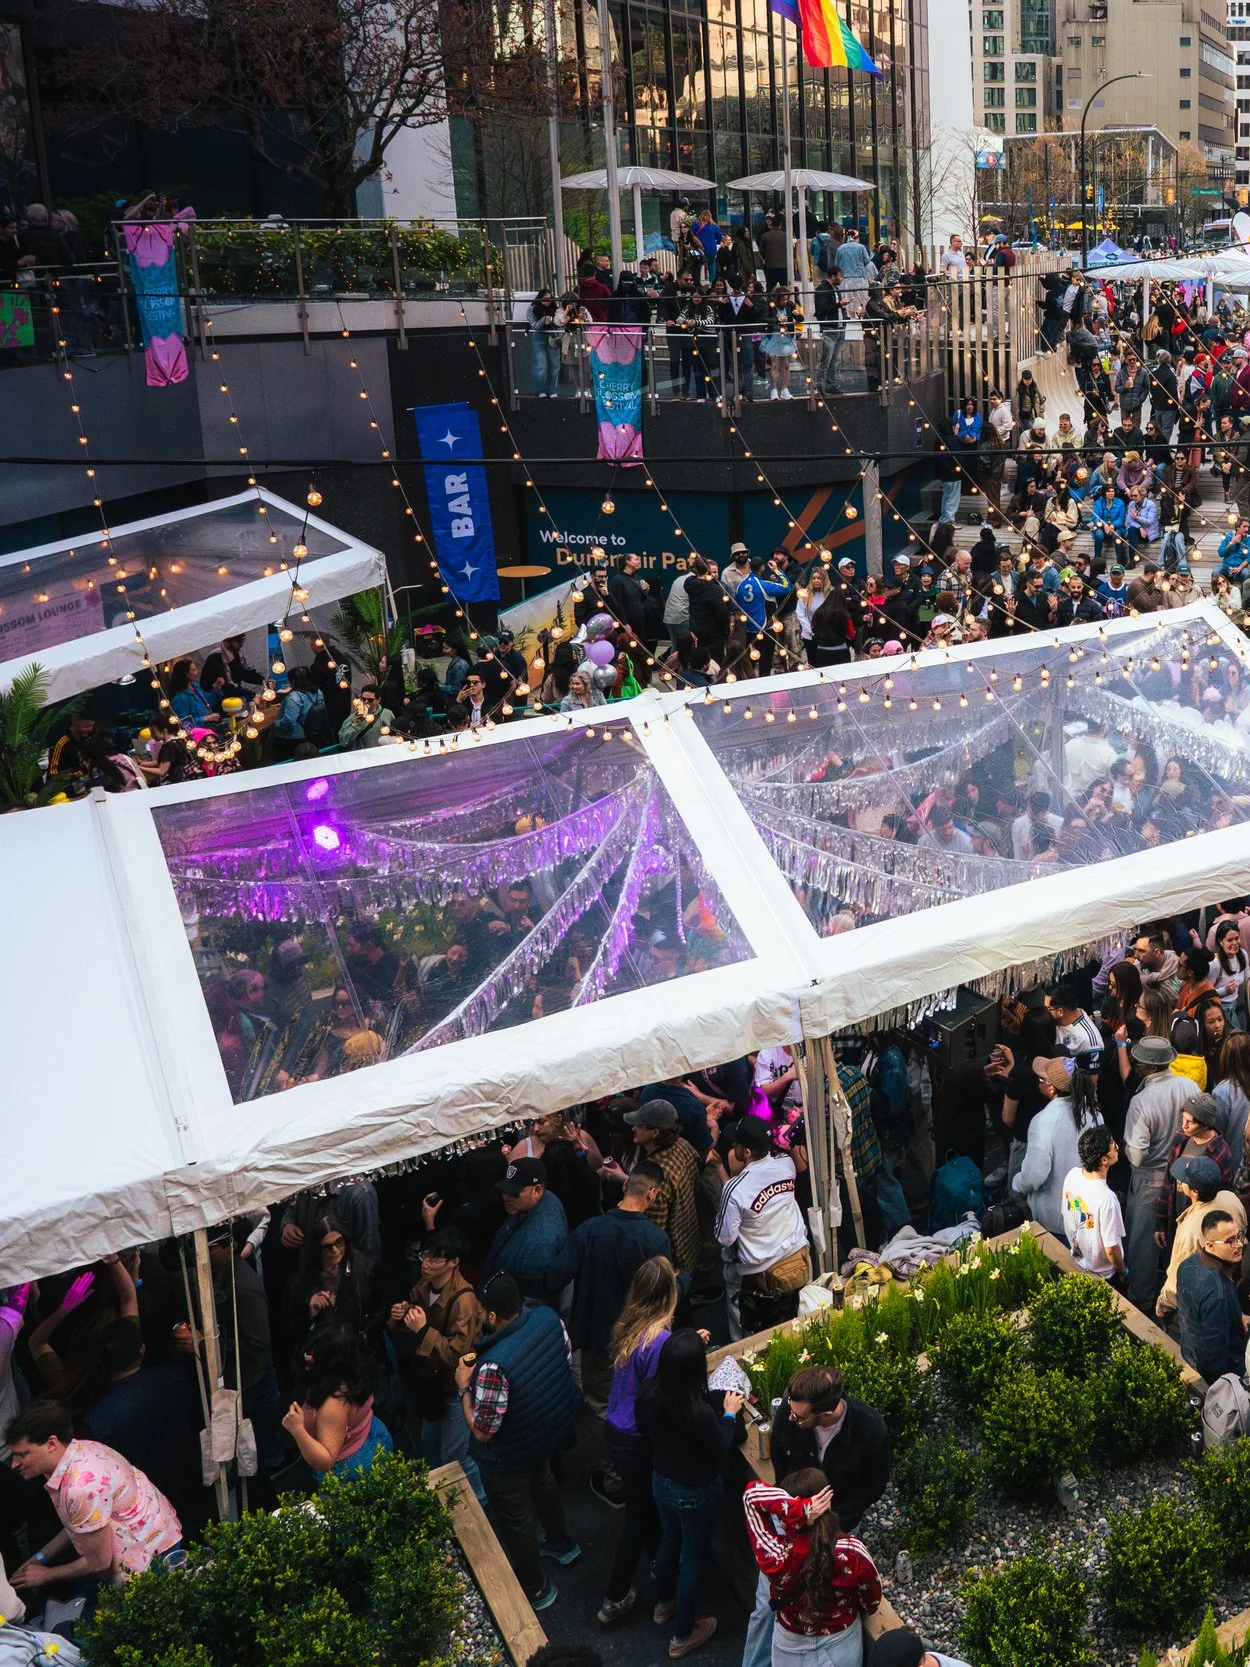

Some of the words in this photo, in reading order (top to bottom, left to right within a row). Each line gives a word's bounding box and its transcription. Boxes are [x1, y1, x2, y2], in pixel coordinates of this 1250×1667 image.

[599, 381, 635, 392] CHERRY
[603, 400, 637, 411] FSTIVAL
[444, 472, 475, 539] BAR
[539, 530, 608, 545] Welcome
[611, 534, 627, 546] to
[556, 547, 657, 568] Dunsmir
[743, 583, 754, 602] 3
[37, 599, 82, 621] LOUNGE
[754, 1182, 788, 1211] adidas
